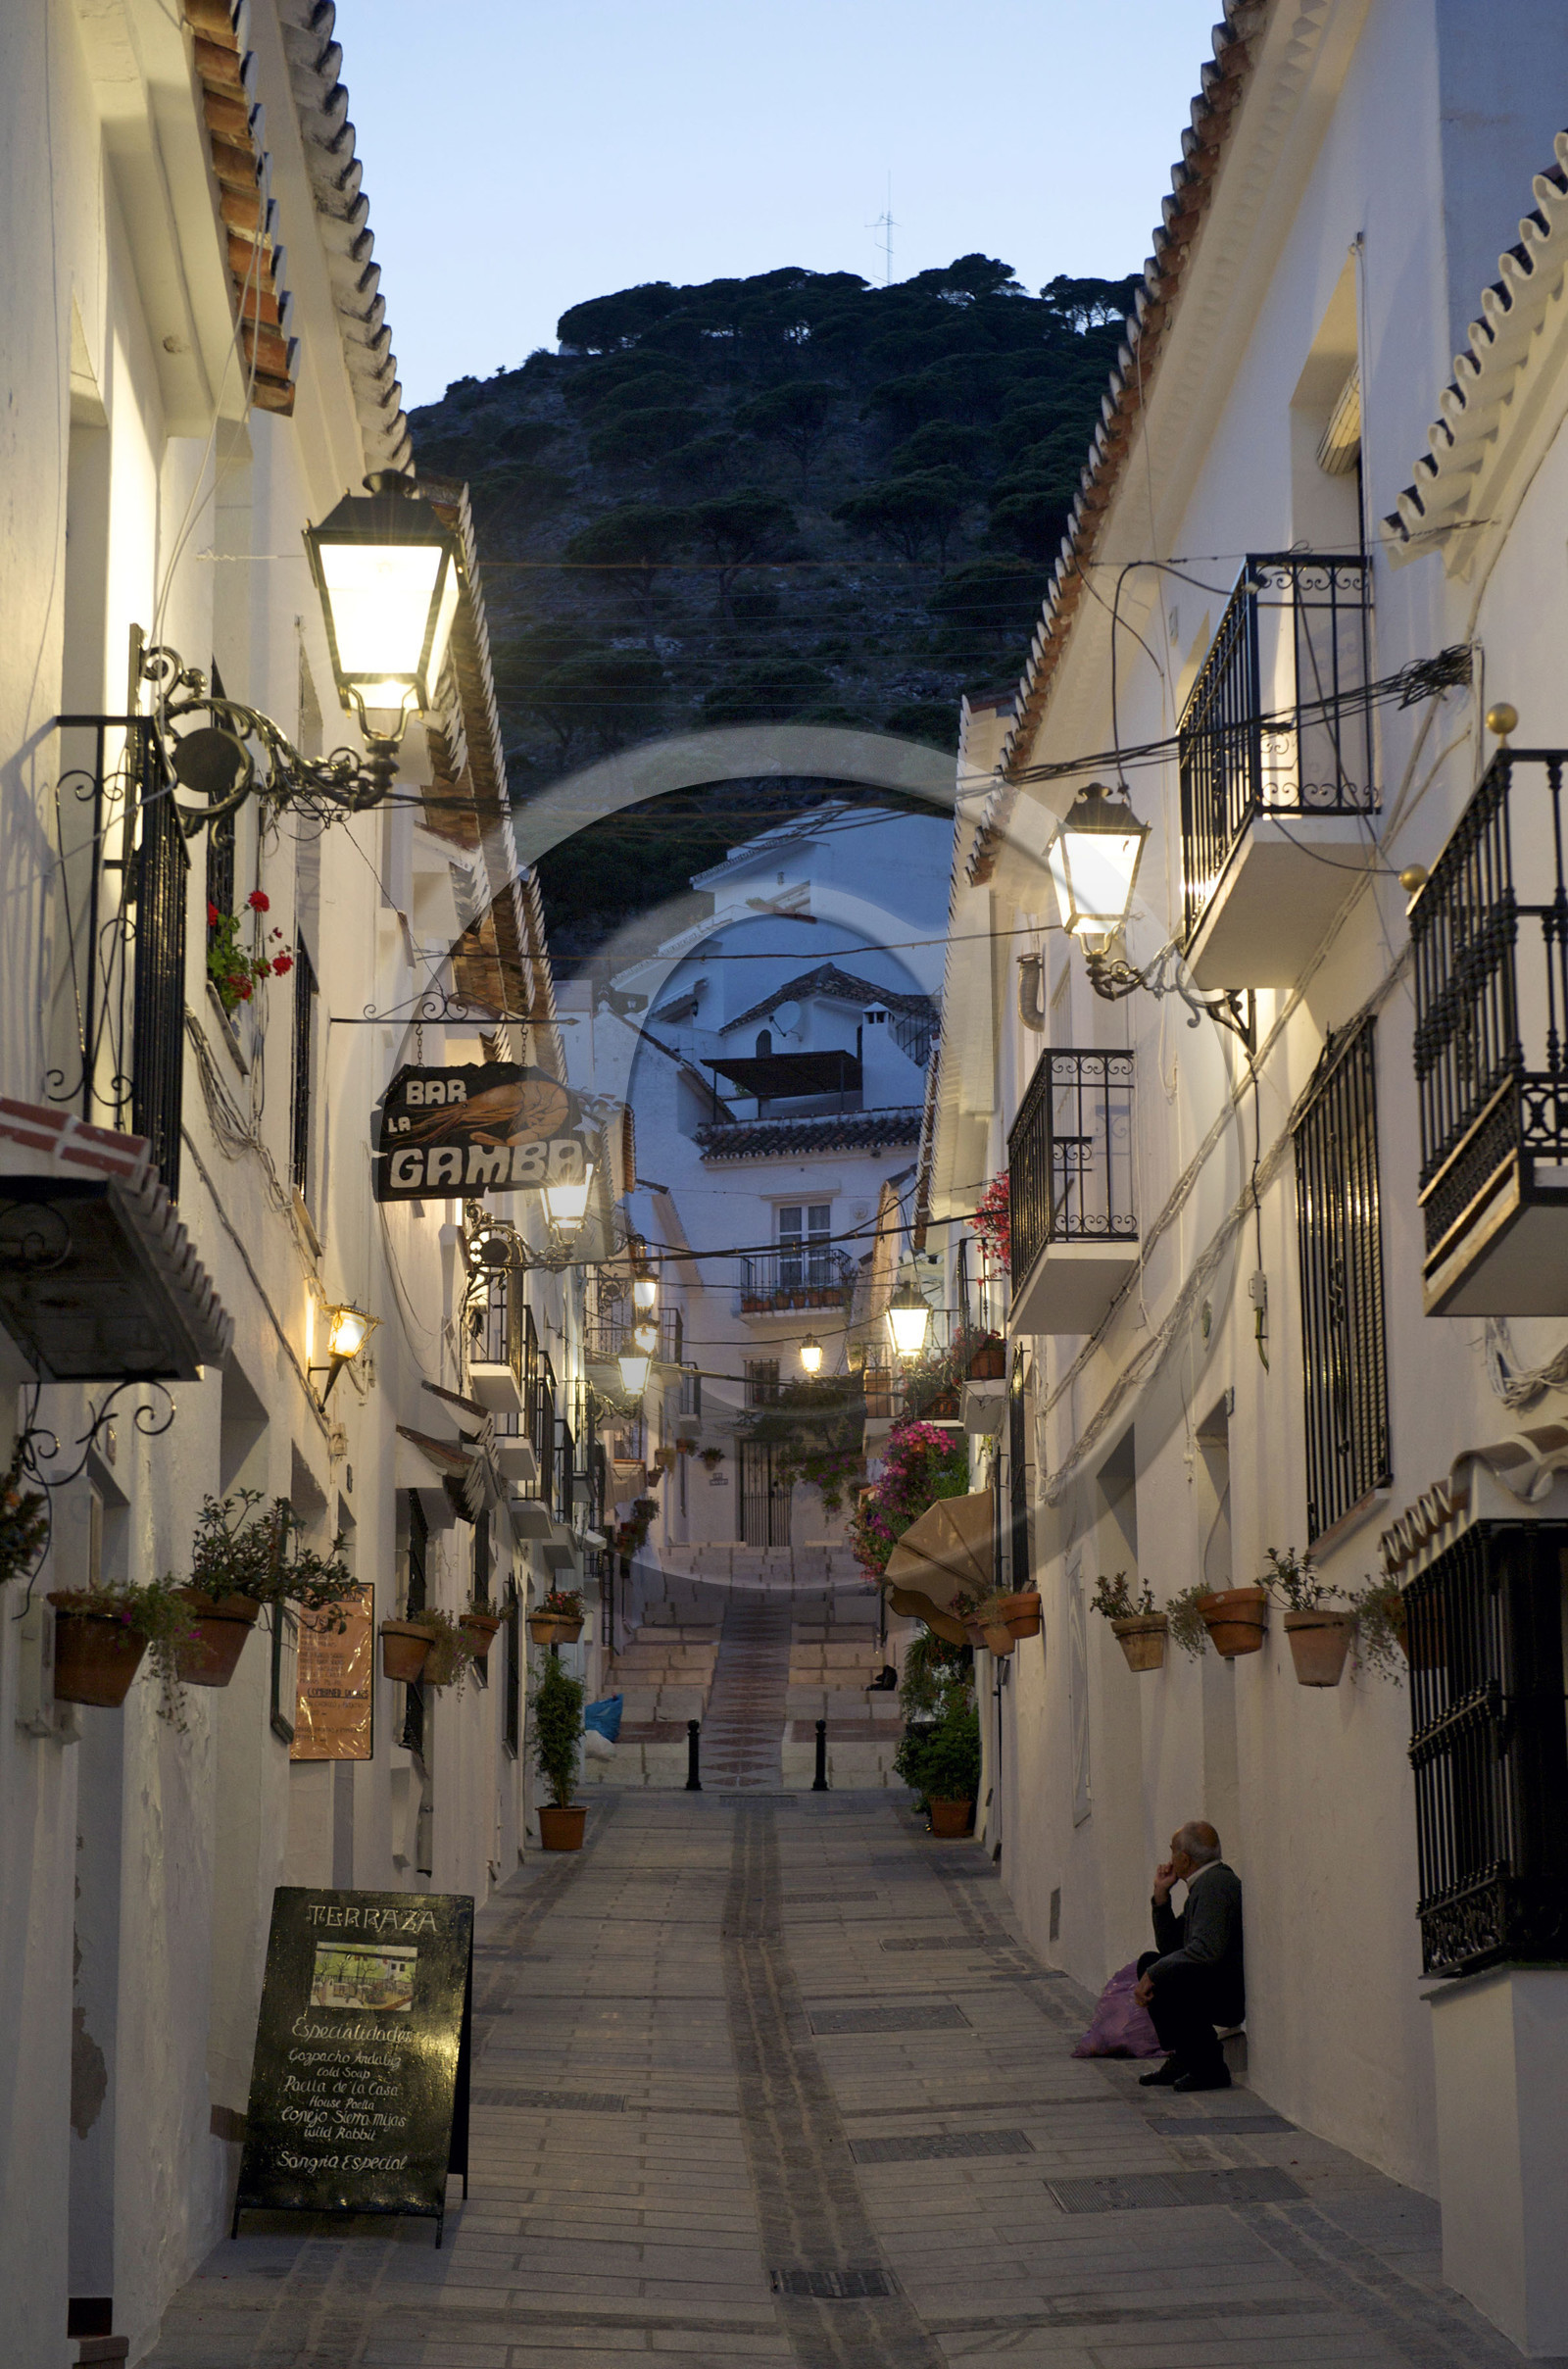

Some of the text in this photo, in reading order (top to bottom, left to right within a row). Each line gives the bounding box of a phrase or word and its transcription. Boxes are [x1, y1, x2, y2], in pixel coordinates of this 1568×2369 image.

[406, 1079, 466, 1105] BAR
[388, 1116, 411, 1133] LA
[390, 1139, 584, 1188] GAMBA
[306, 1904, 438, 1934] TERRAZA
[292, 2016, 413, 2043] Especialidades
[317, 2065, 340, 2078] Cold
[282, 2075, 399, 2097] Paella de la Casa
[310, 2095, 375, 2111] House Paella
[281, 2105, 328, 2128] Conejo
[332, 2109, 369, 2126] Sierra
[335, 2127, 376, 2141] Rabbit
[342, 2154, 409, 2173] Especial
